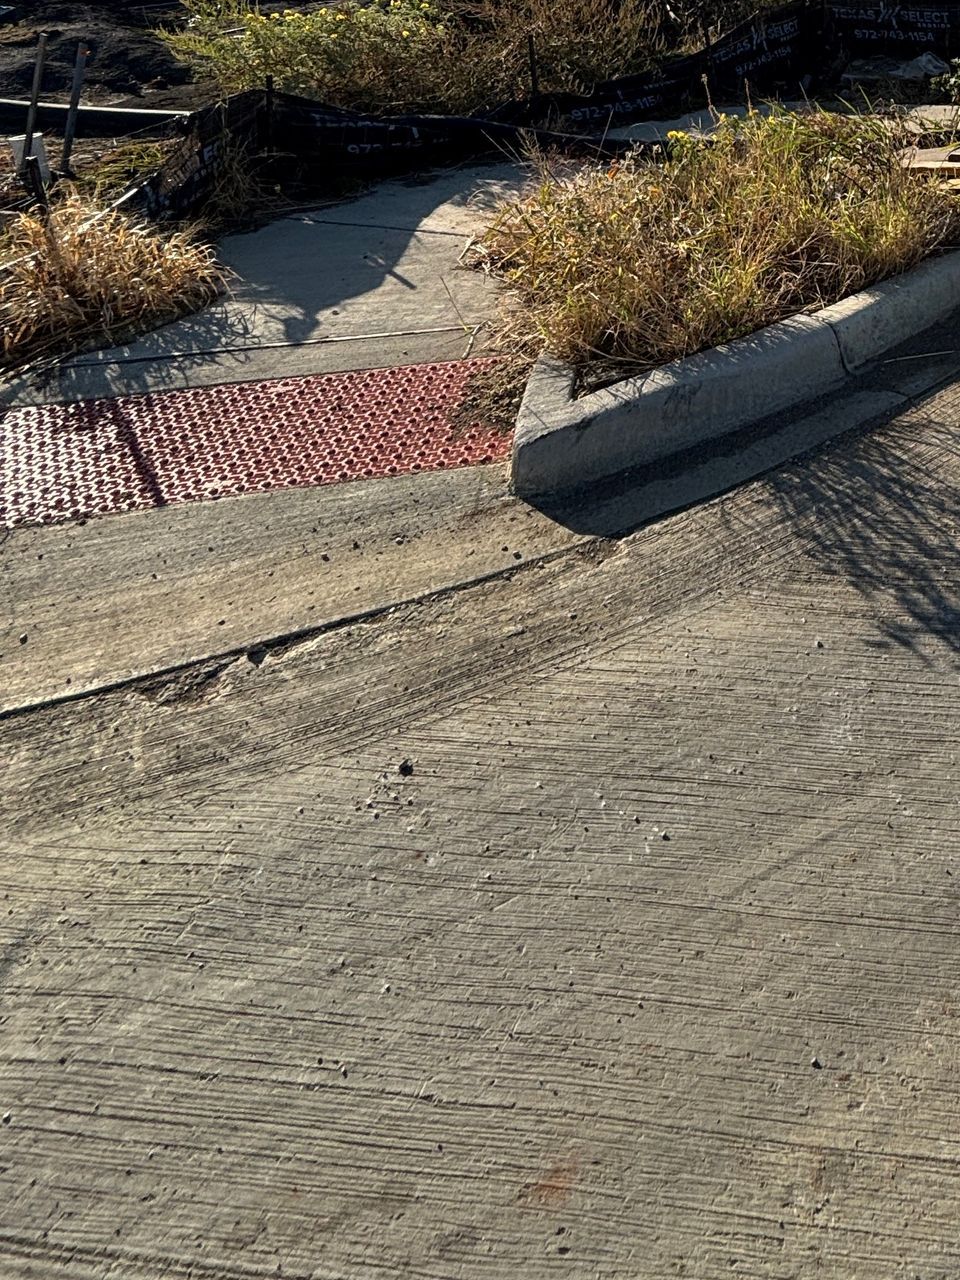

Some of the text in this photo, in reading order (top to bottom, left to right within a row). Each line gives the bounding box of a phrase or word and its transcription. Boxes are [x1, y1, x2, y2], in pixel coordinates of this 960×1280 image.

[831, 7, 949, 24] TEXAS SELECT
[767, 19, 799, 40] SELECT
